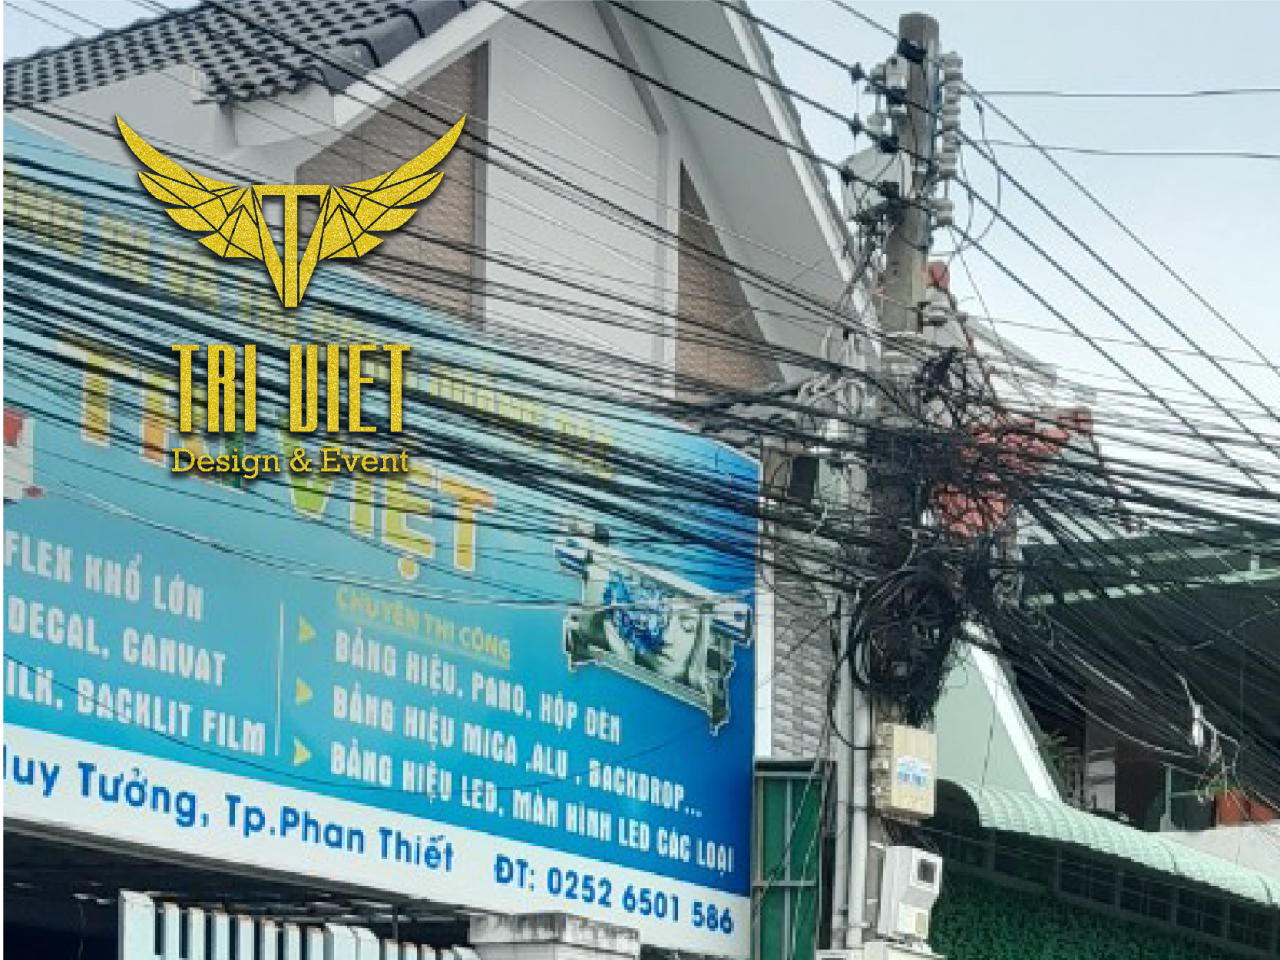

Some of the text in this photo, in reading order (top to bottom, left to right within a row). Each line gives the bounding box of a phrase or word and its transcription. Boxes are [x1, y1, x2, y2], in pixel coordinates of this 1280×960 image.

[77, 677, 193, 738] BACKLIT
[201, 708, 266, 756] FILM
[461, 722, 517, 767] MICA
[617, 816, 651, 852] LED
[493, 852, 536, 893] ĐT:
[547, 865, 613, 910] 0252
[621, 882, 681, 924] 6501
[690, 900, 735, 936] 586
